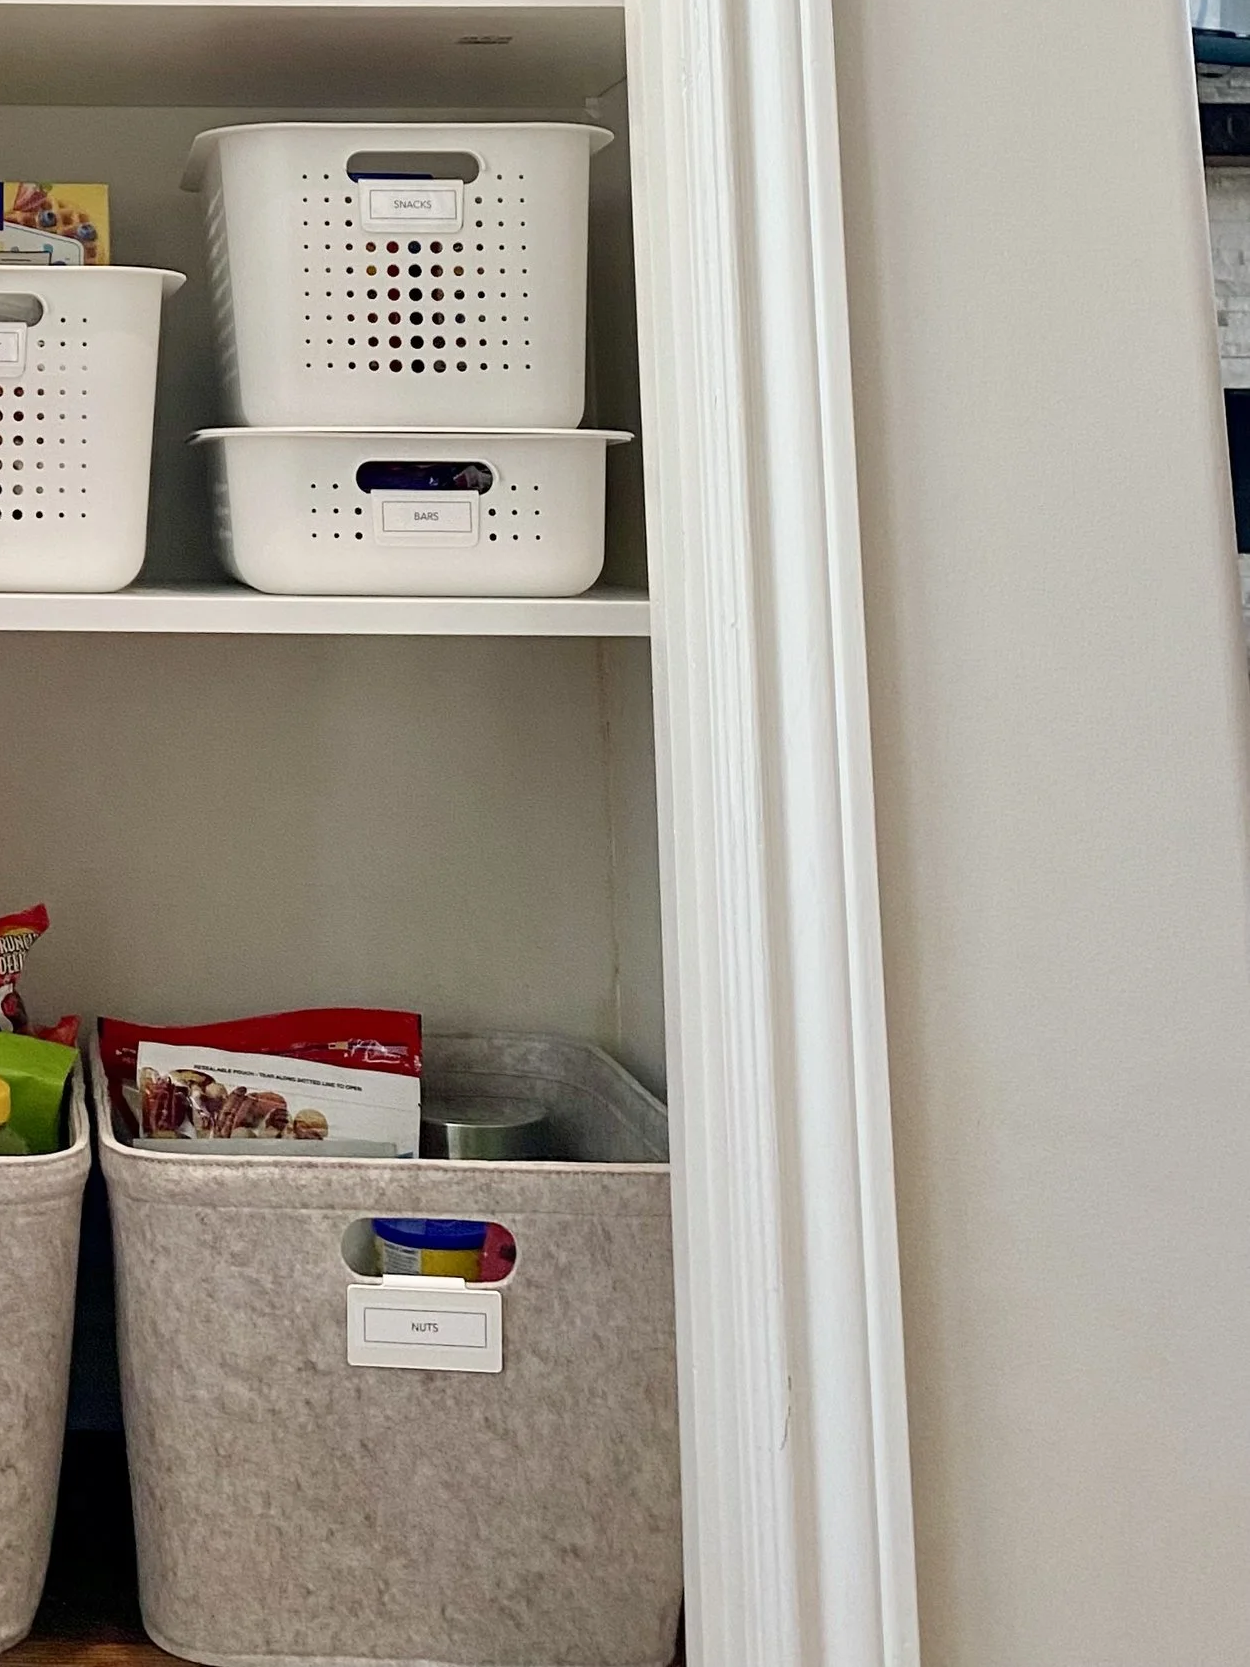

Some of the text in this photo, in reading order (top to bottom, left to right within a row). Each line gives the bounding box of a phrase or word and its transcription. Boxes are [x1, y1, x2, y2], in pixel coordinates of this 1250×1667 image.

[394, 199, 432, 209] SNACKS
[413, 512, 439, 521] BARS
[345, 1084, 363, 1092] OPEN
[411, 1323, 439, 1332] NUTS
